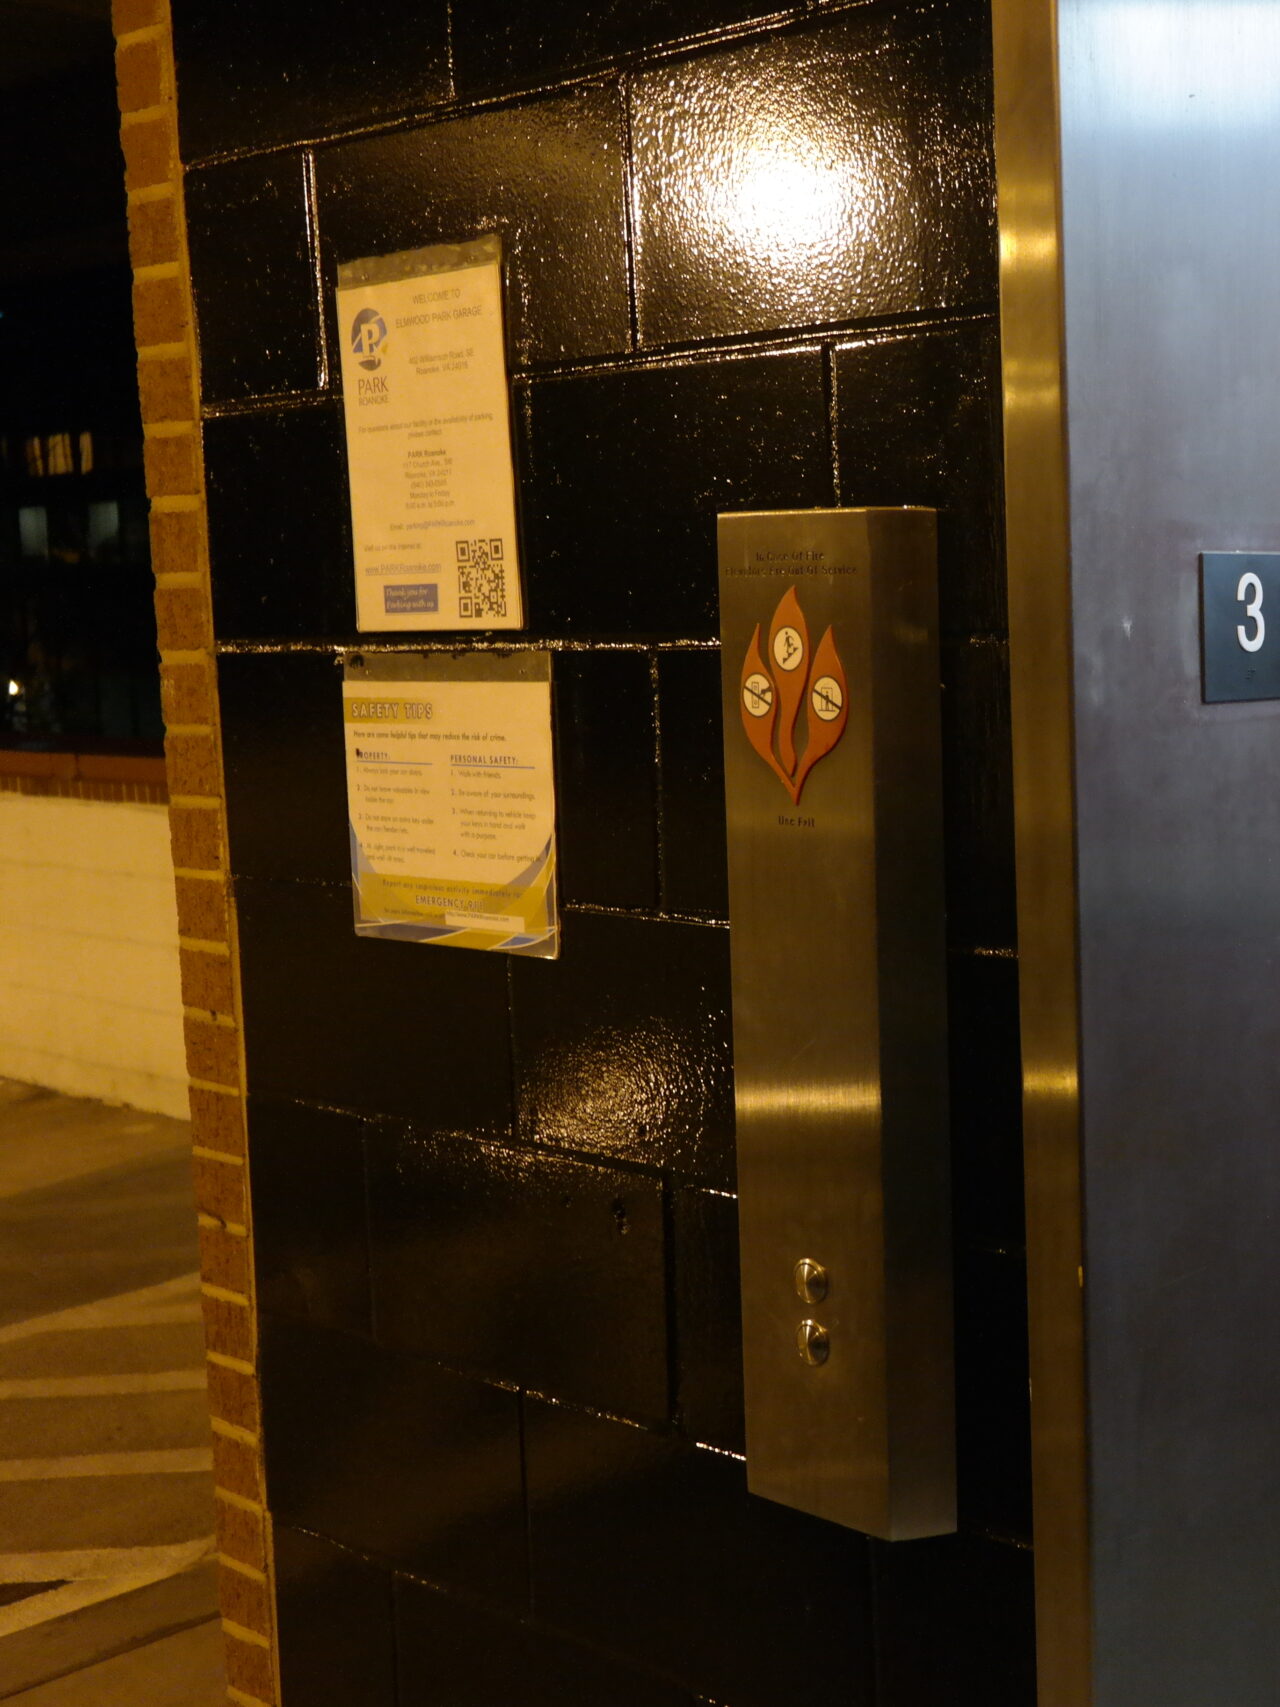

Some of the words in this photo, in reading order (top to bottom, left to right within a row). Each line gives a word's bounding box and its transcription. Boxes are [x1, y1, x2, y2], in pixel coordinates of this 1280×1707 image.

[395, 313, 430, 329] ELMWOOD
[432, 311, 452, 322] PARK
[453, 305, 482, 321] GARAGE
[358, 375, 389, 396] PARK
[1237, 572, 1265, 652] 3
[352, 702, 399, 718] SAFETY
[403, 702, 433, 719] TIPS
[353, 730, 366, 738] Here
[390, 730, 407, 740] helpful
[442, 732, 460, 740] reduce
[461, 732, 470, 740] the
[471, 732, 481, 741] risk
[450, 755, 487, 765] PERSONAL
[489, 756, 518, 765] SAFETY:
[778, 815, 796, 827] Use
[415, 895, 465, 911] EMERGENCY
